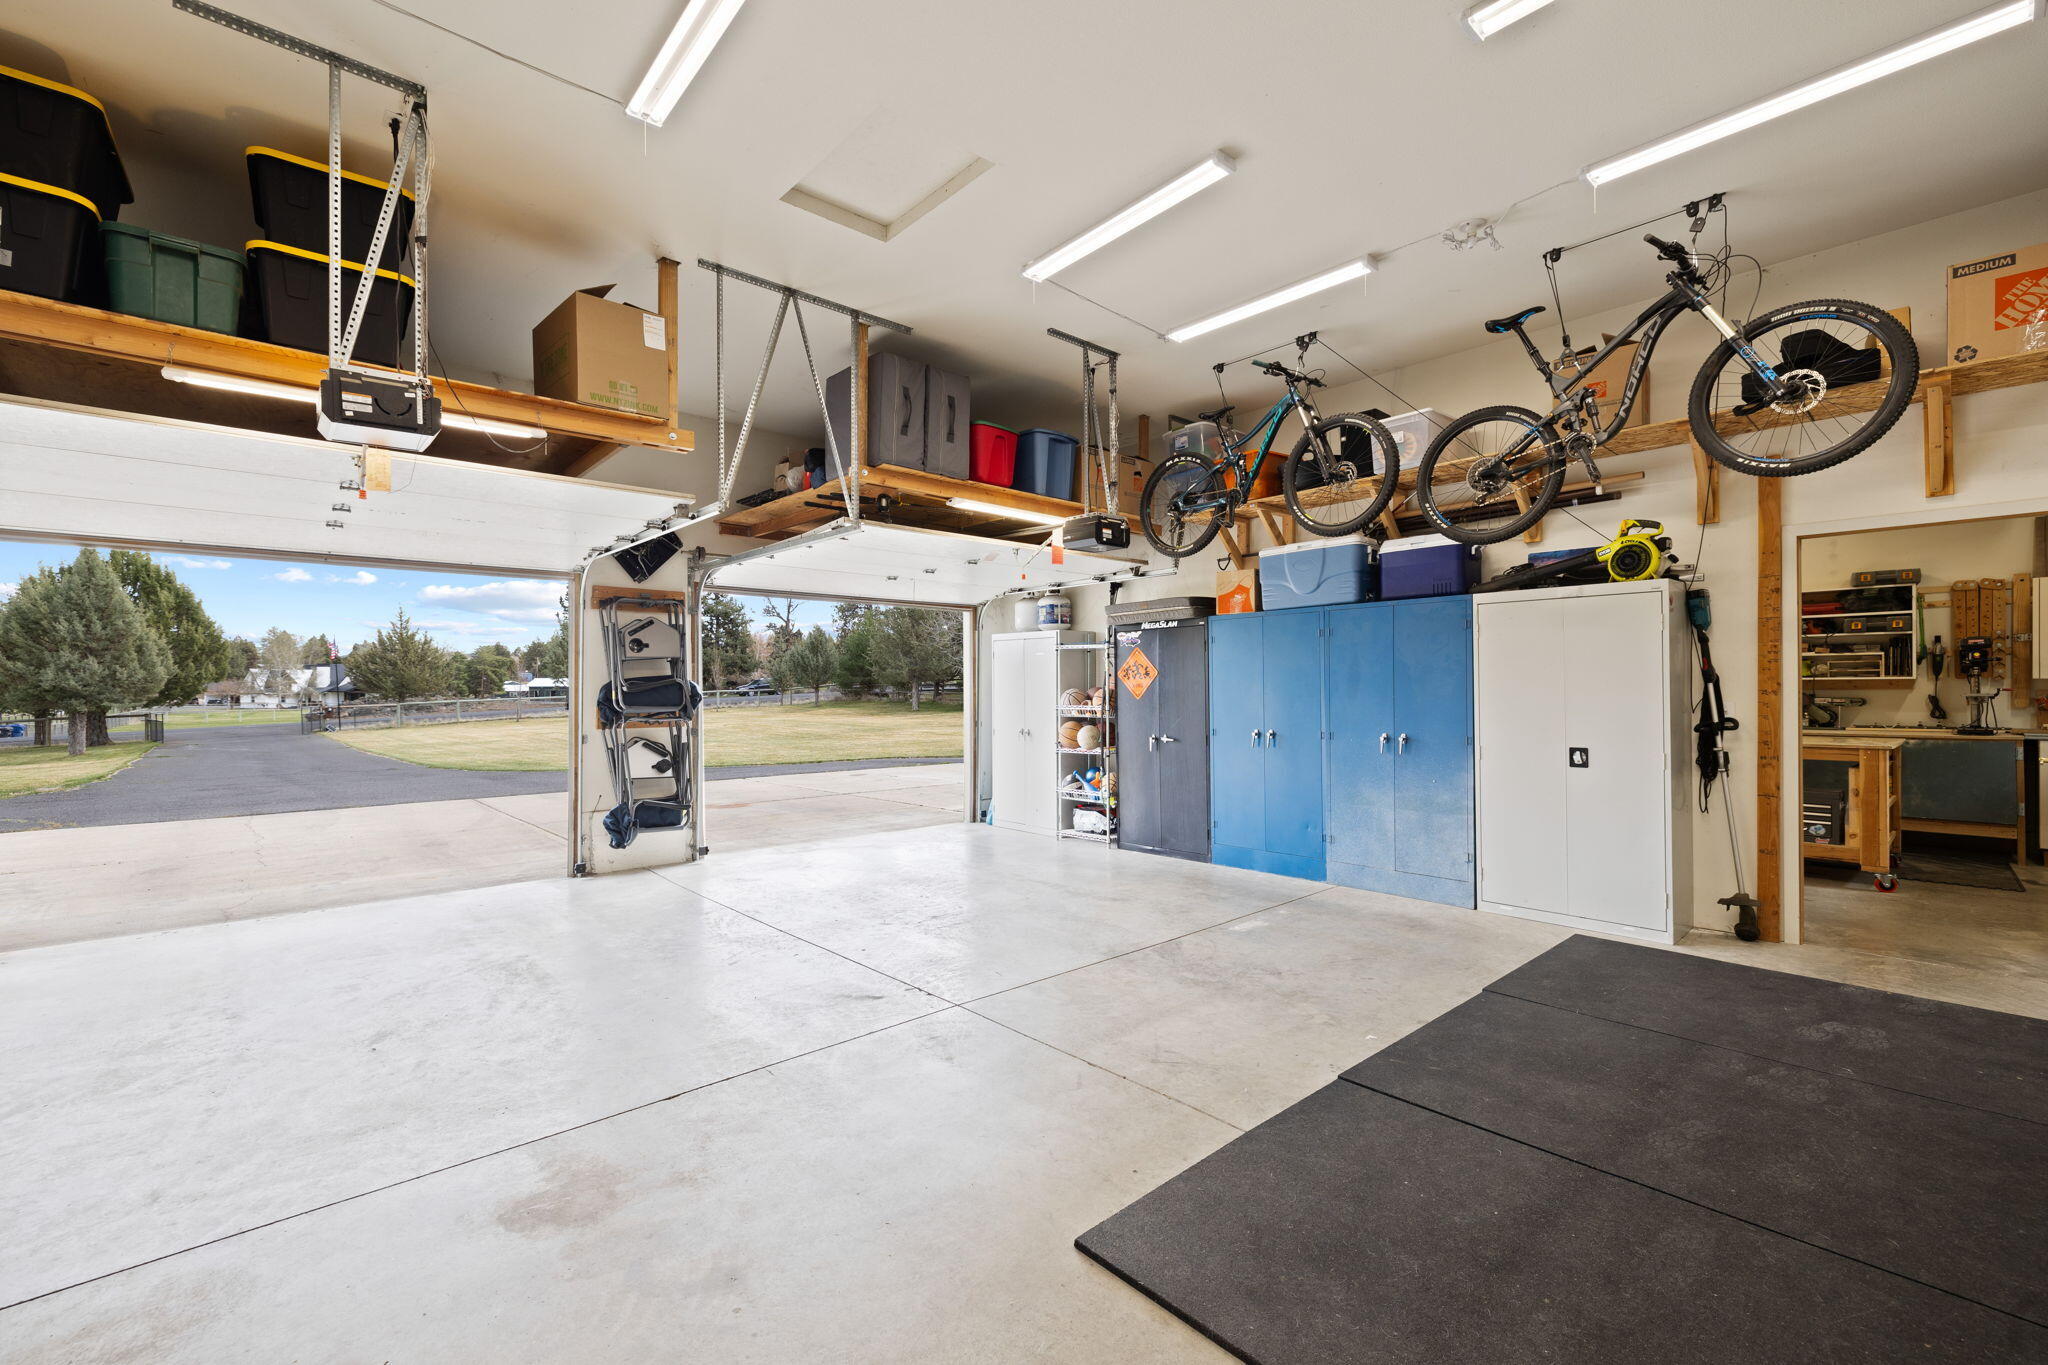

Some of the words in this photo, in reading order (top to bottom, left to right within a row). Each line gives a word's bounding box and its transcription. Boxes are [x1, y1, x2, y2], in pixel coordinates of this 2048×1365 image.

[1956, 256, 2013, 277] MEDIUM
[2002, 276, 2034, 302] THE
[1619, 315, 1662, 418] NORCO
[1165, 457, 1201, 467] MAXXIS
[1736, 457, 1792, 468] MAXXIS
